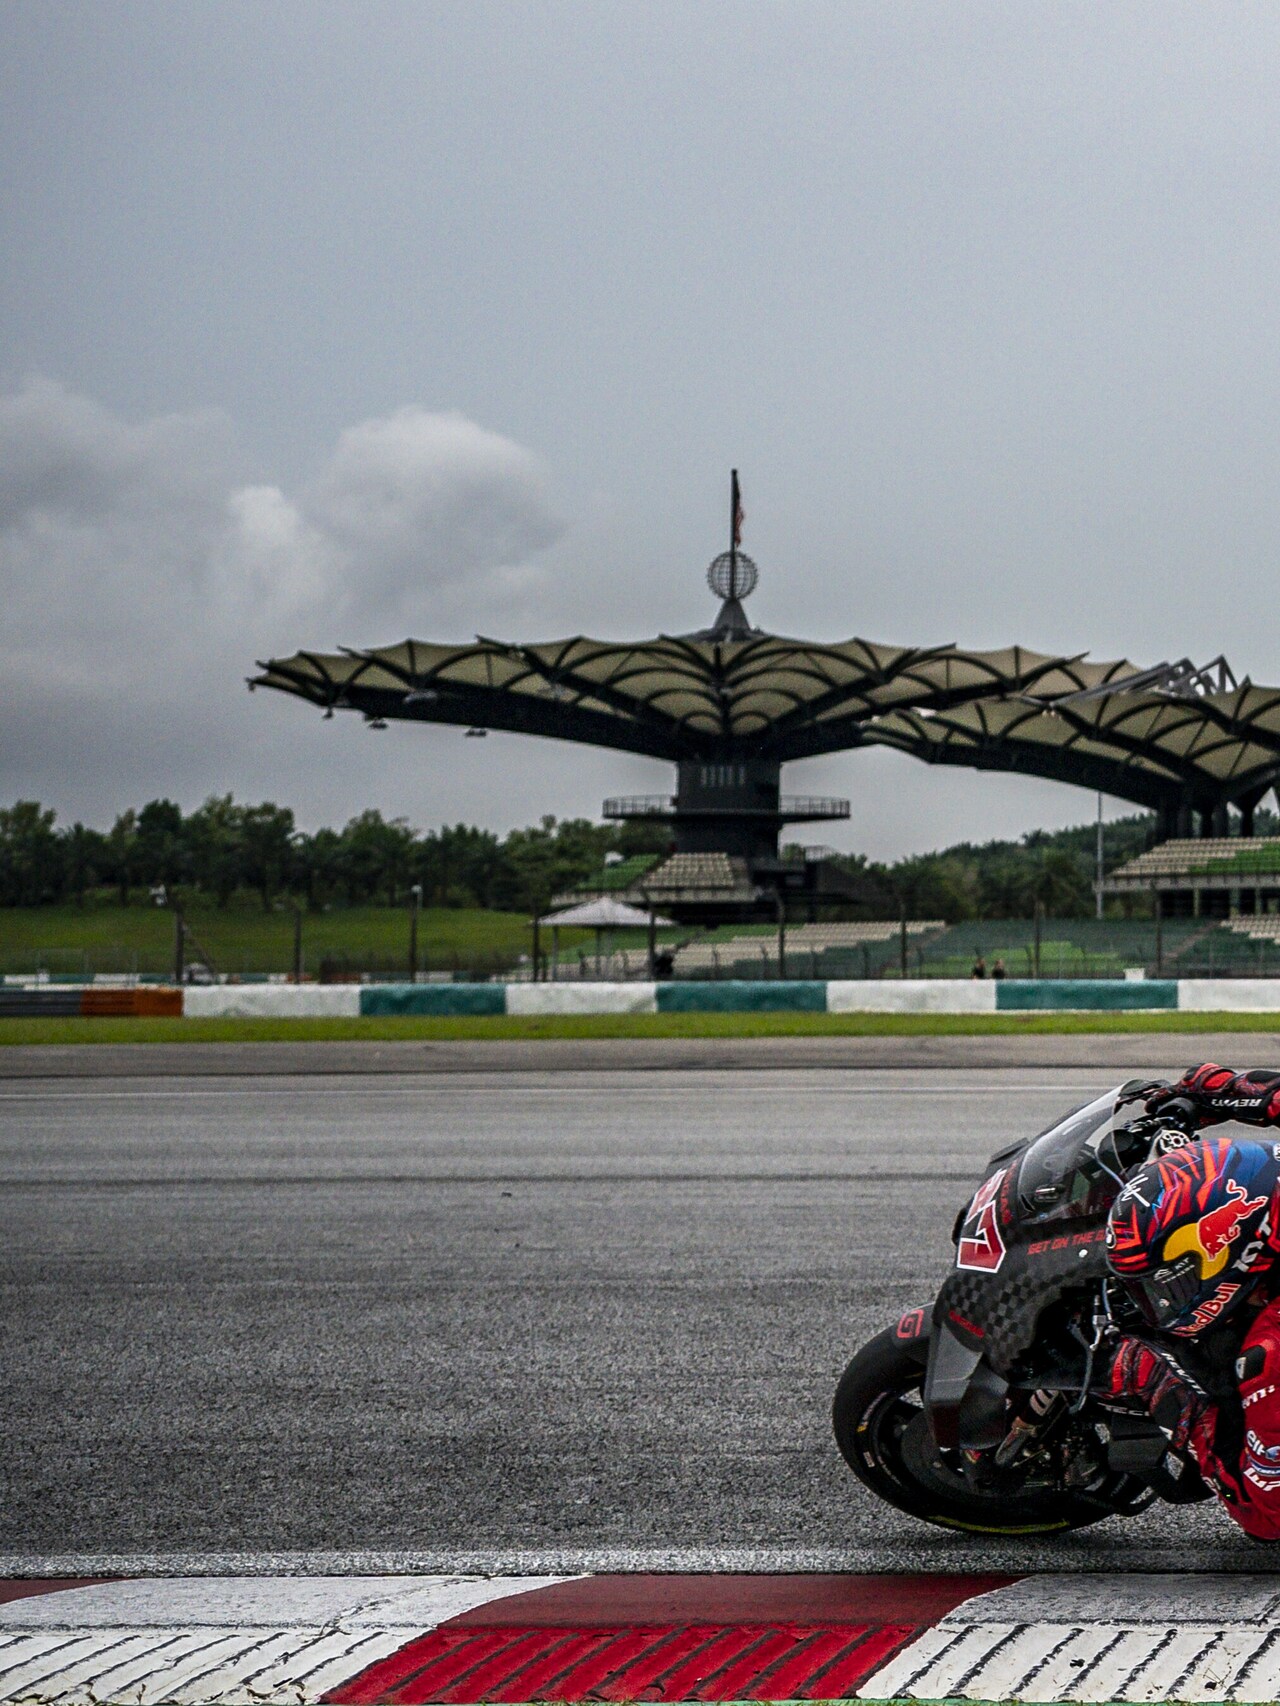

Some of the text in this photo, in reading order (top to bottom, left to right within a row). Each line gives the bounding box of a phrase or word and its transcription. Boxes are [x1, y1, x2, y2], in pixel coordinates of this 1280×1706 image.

[1027, 1240, 1051, 1255] GET
[1051, 1237, 1069, 1250] ON
[1071, 1231, 1096, 1246] THE
[1197, 1282, 1241, 1317] Bull
